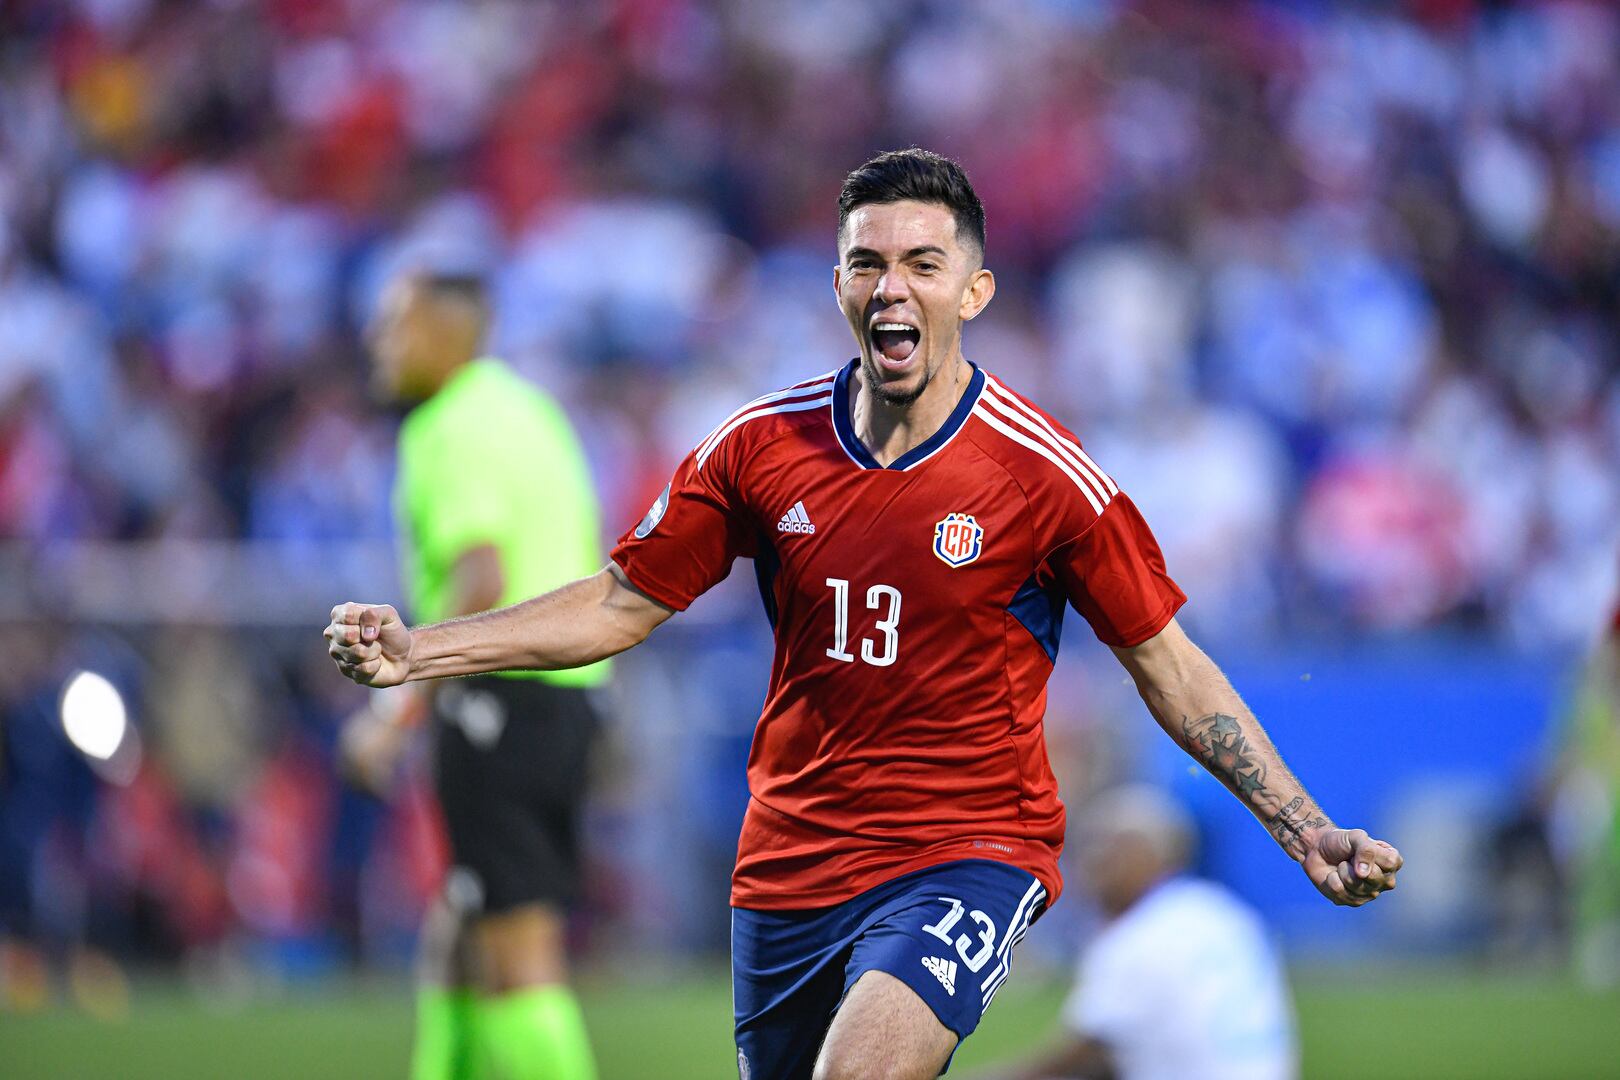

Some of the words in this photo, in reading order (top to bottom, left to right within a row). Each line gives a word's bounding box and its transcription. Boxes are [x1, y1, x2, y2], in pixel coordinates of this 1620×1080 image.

[777, 521, 816, 535] adidas
[944, 524, 972, 557] CR
[826, 578, 902, 667] 13
[922, 897, 996, 973] 13
[921, 956, 956, 996] adidas
